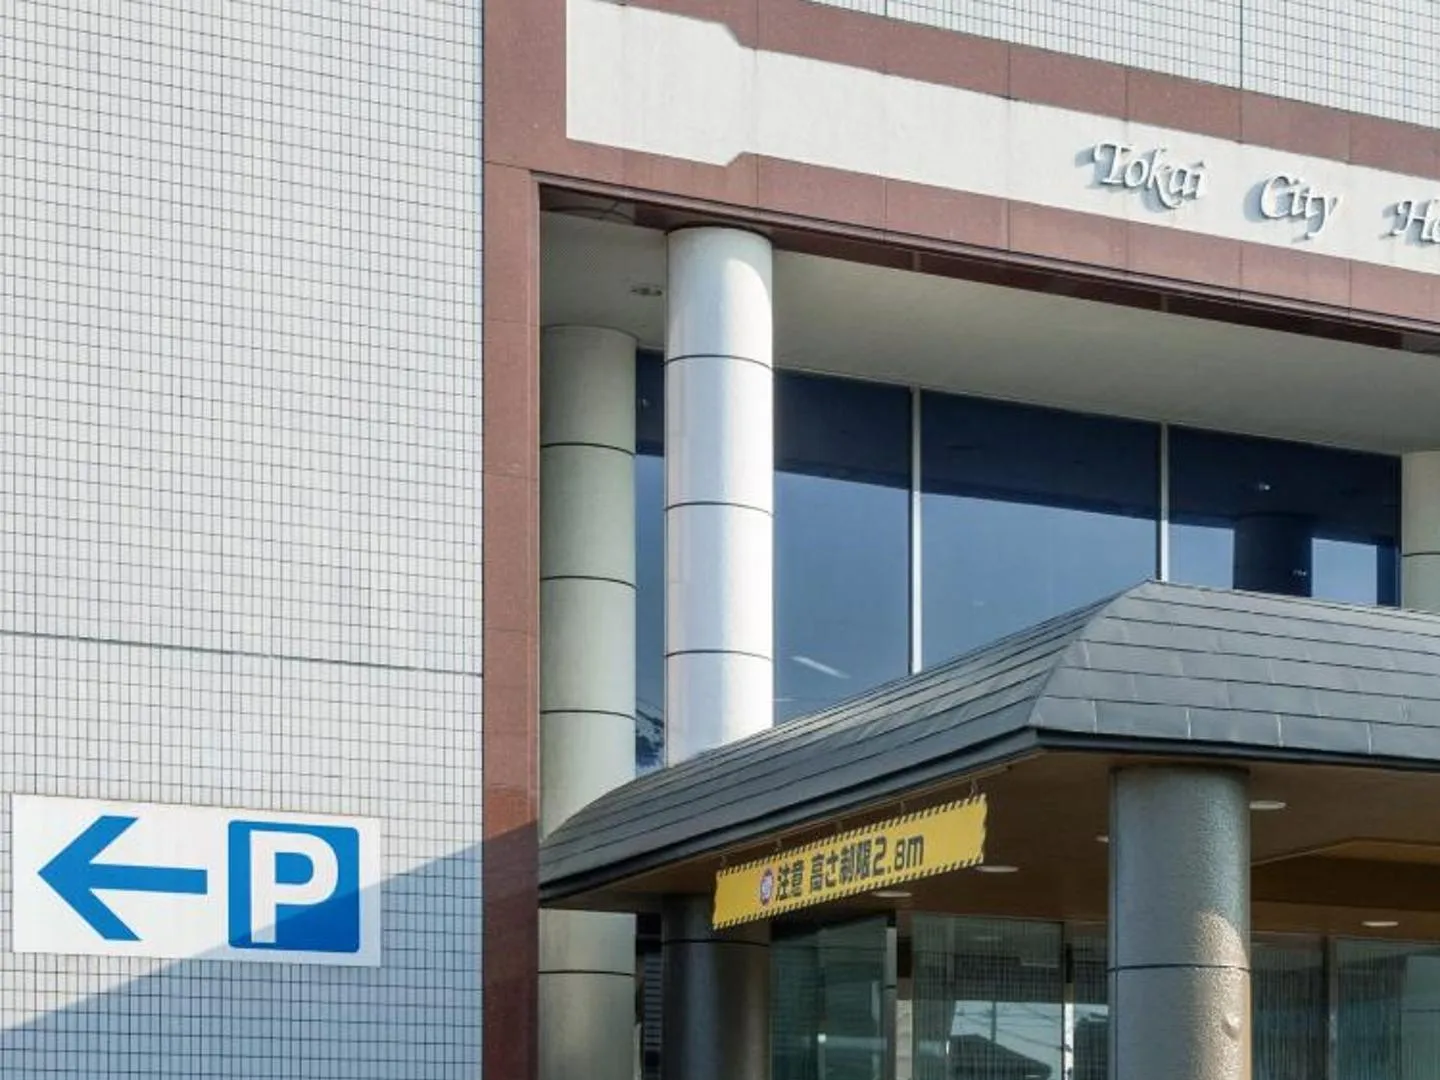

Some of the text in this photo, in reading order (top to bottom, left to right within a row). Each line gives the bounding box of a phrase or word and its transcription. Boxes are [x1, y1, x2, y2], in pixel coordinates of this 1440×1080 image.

[1092, 141, 1205, 209] Tokai
[1258, 173, 1342, 240] City
[250, 829, 339, 943] P
[776, 859, 804, 901] 注意
